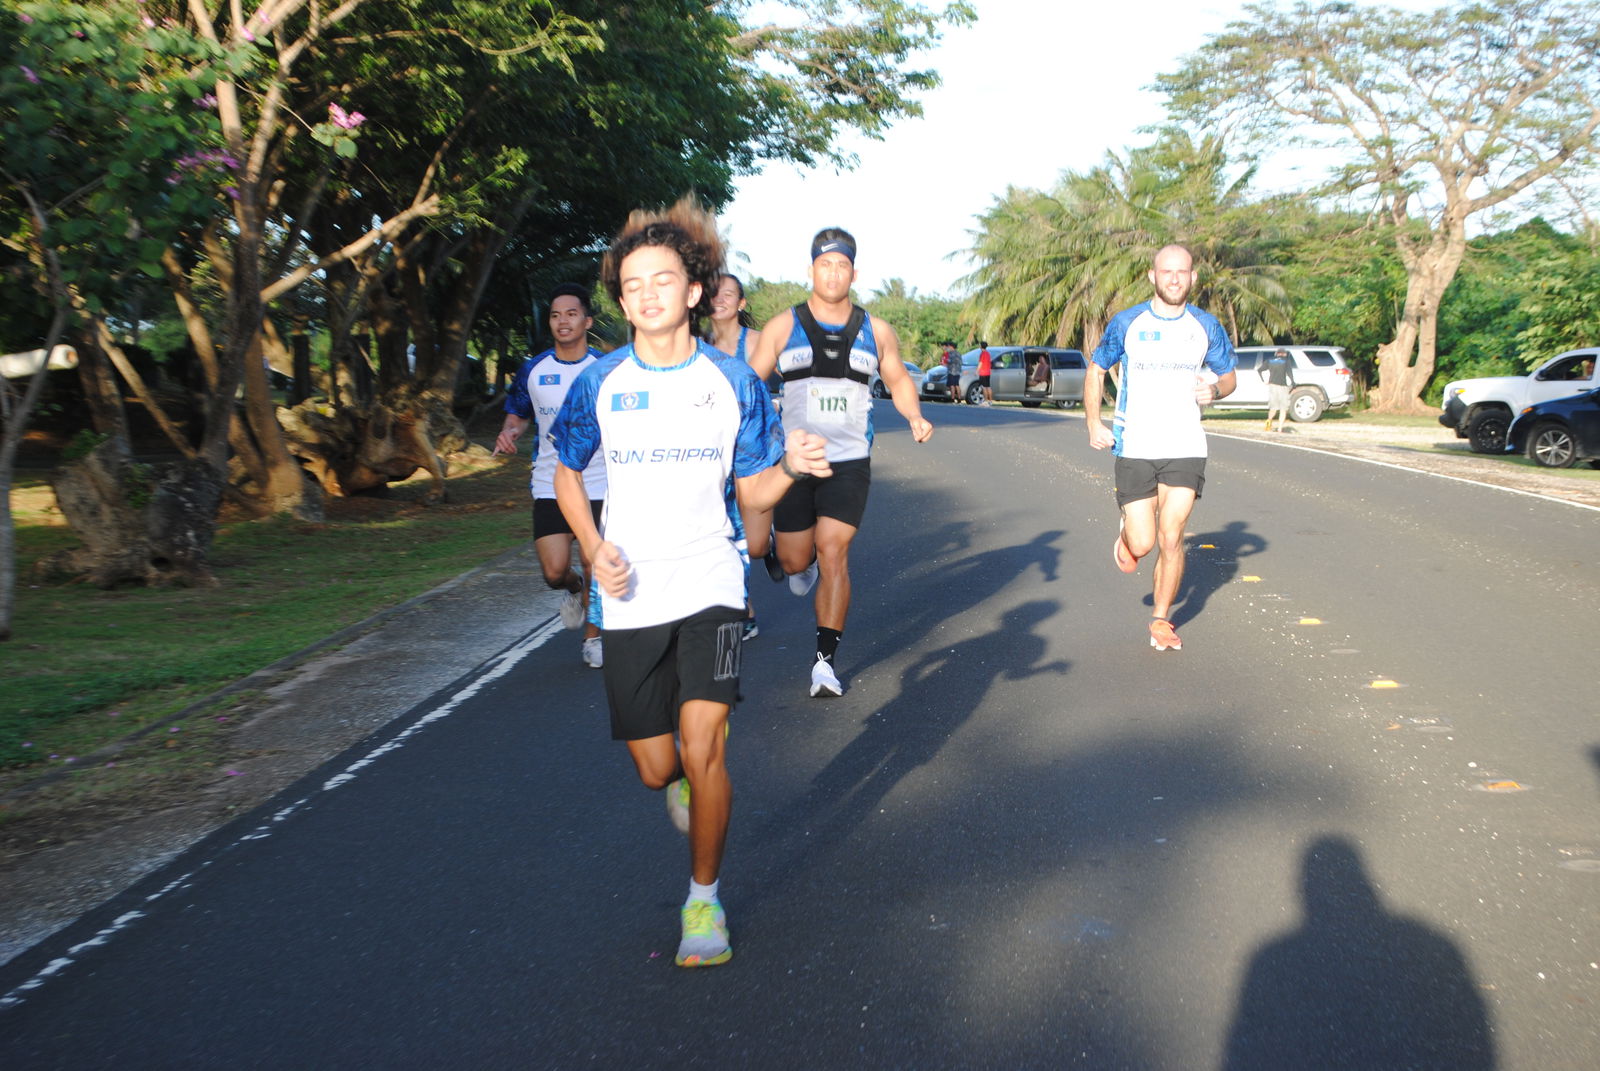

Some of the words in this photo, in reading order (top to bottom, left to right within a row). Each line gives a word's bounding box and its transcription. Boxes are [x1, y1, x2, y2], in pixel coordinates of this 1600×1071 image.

[792, 350, 813, 363] RU
[818, 397, 847, 411] 1173
[538, 406, 559, 416] RUN
[608, 449, 645, 464] RUN
[650, 446, 724, 462] SAIPAN
